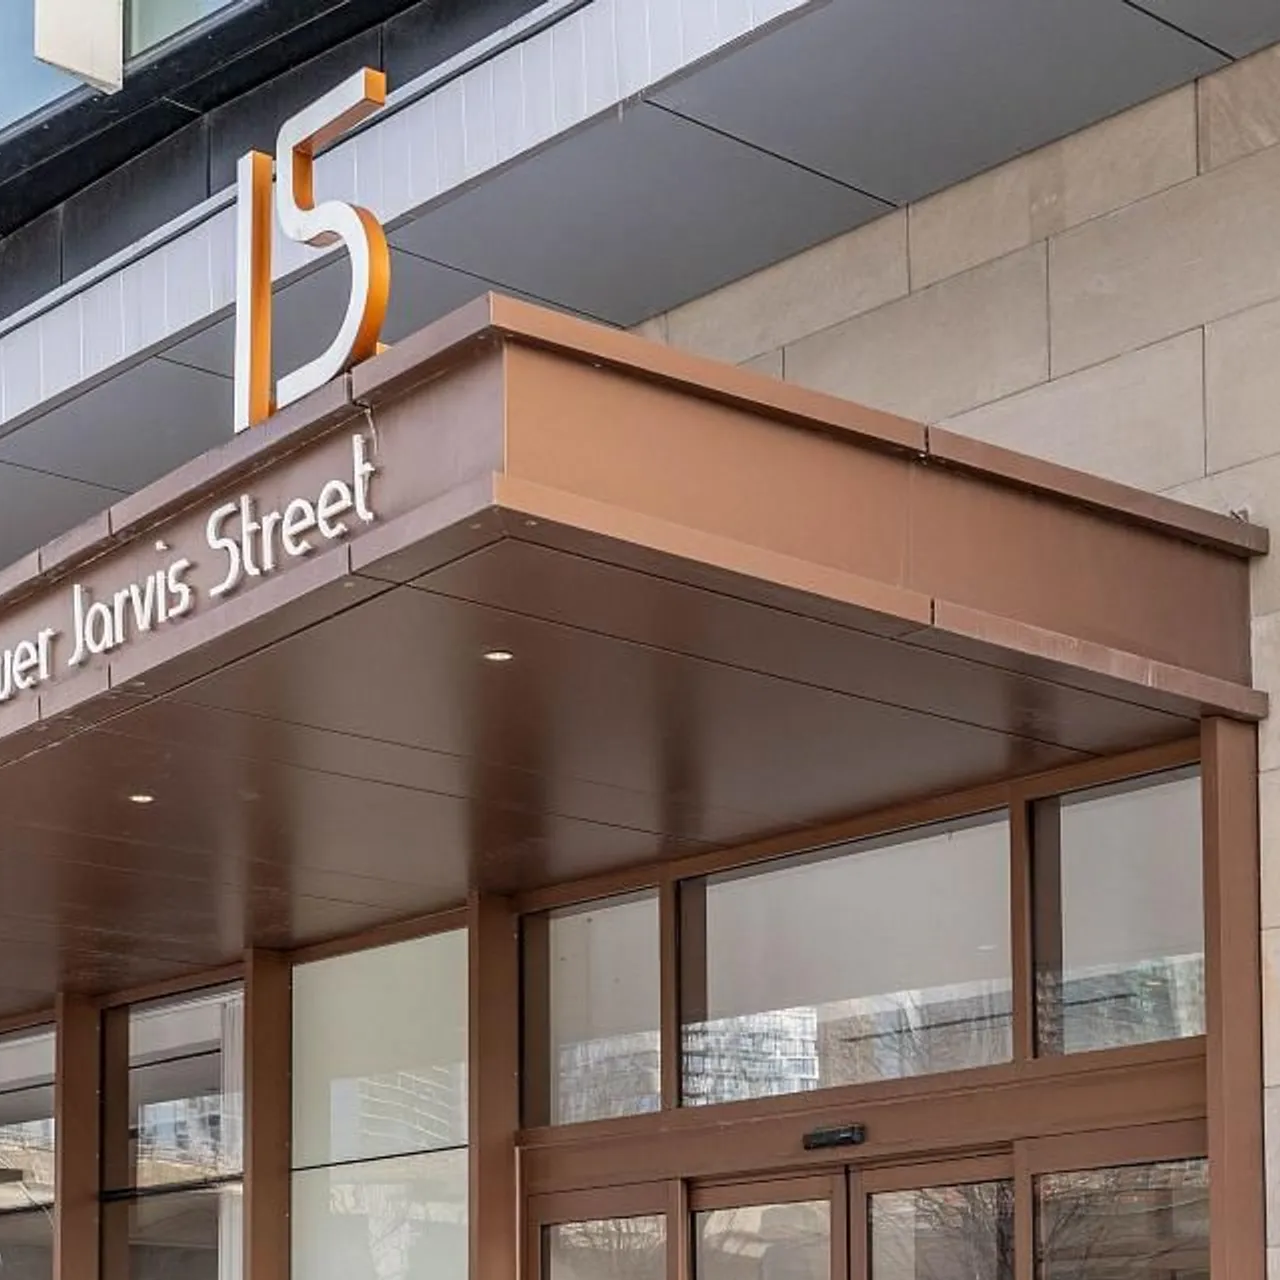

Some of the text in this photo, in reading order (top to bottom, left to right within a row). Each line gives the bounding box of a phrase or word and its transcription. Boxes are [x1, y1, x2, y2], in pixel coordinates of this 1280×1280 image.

[234, 67, 389, 433] 15
[68, 540, 193, 667] Jarvis
[206, 434, 375, 598] Street
